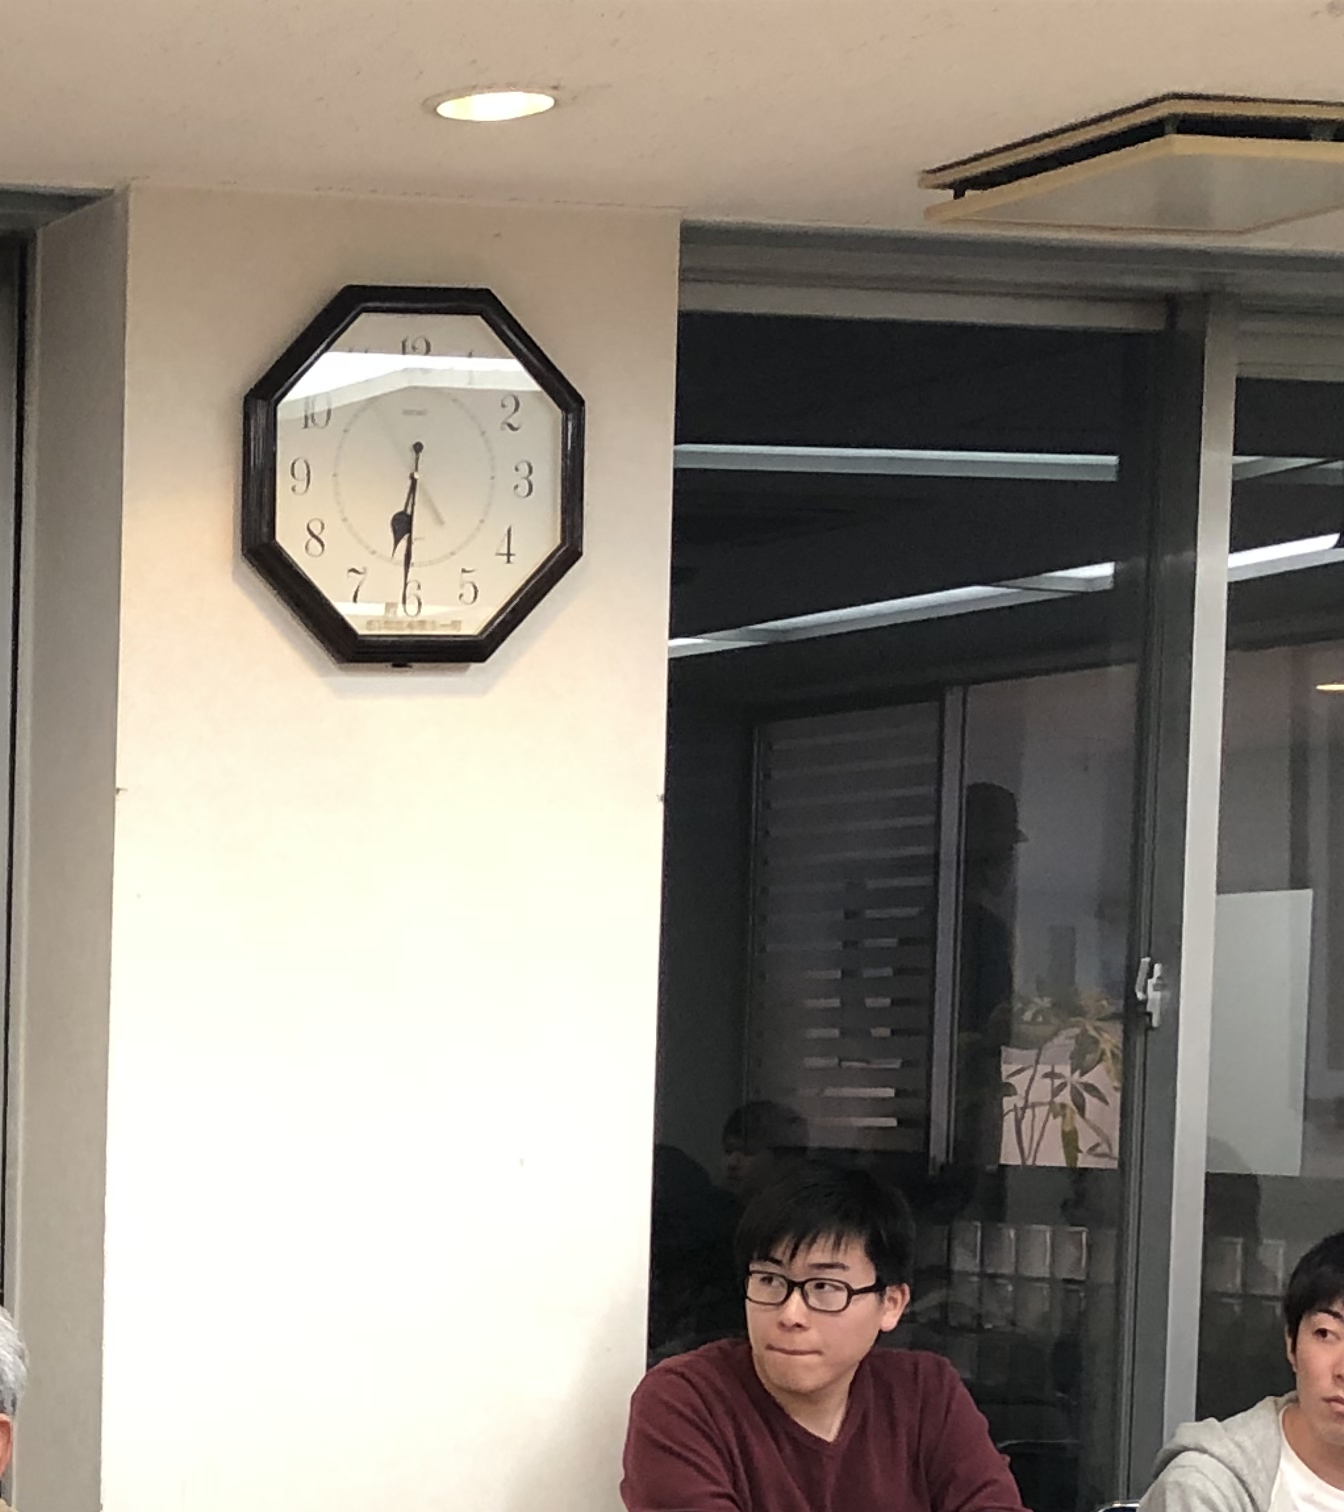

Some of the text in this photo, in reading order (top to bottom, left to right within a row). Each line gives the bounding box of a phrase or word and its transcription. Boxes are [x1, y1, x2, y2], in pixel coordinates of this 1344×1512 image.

[302, 390, 332, 429] 10
[500, 393, 521, 431] 2
[290, 456, 311, 496] 9
[513, 459, 534, 498] 3
[304, 517, 326, 558] 8
[494, 525, 516, 565] 4
[347, 566, 367, 604] 7
[401, 578, 423, 618] 6
[458, 567, 480, 606] 5
